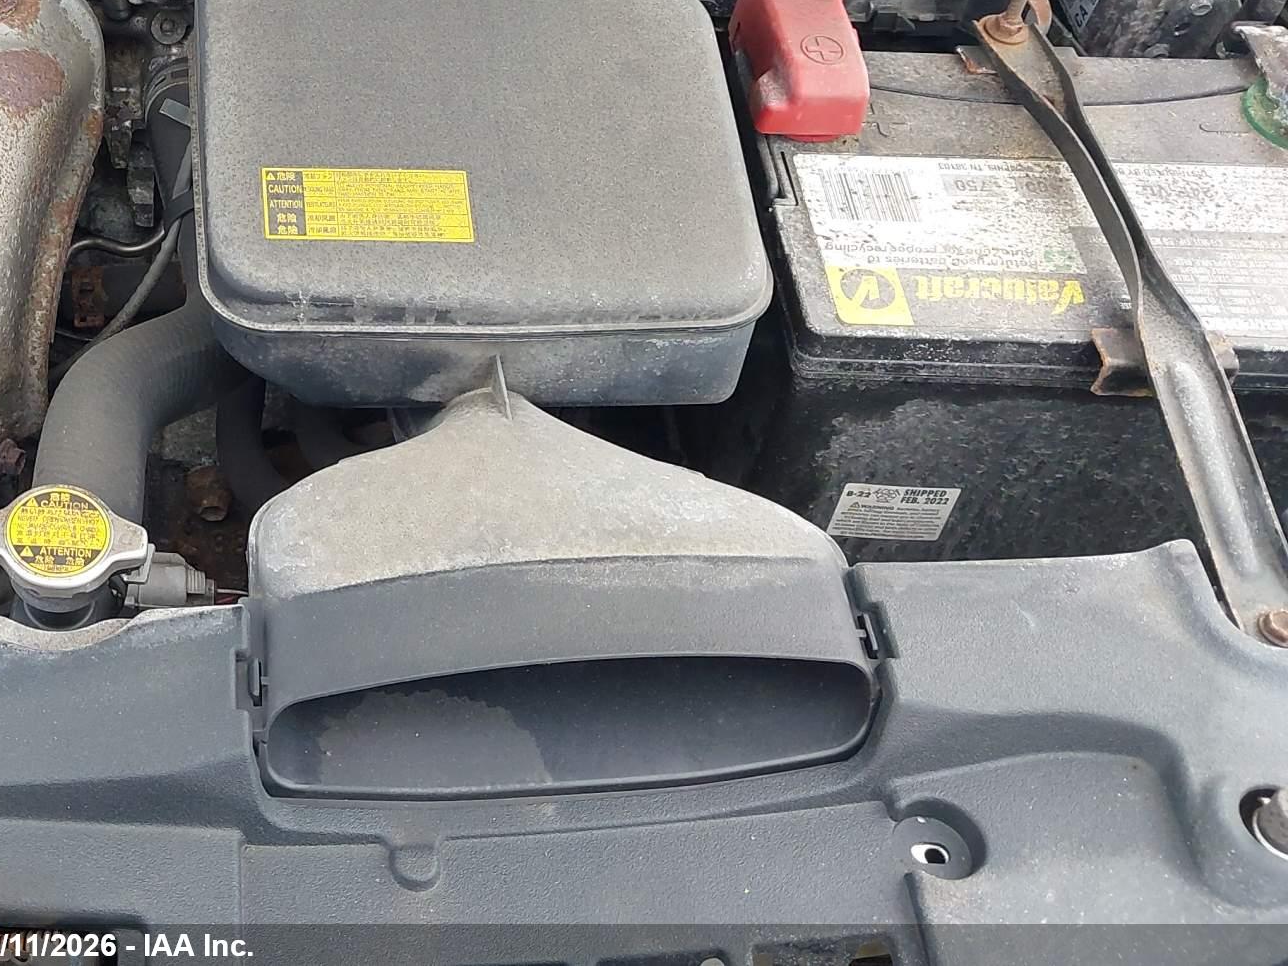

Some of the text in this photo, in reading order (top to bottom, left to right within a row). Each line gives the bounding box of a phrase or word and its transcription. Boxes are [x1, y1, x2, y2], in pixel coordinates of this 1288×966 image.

[268, 184, 304, 194] CAUTION
[269, 199, 304, 209] ATTENTION
[825, 241, 889, 254] recycling
[845, 490, 872, 498] B-22
[903, 488, 948, 498] SHIPPED
[40, 499, 89, 509] CAUTION
[899, 496, 950, 505] FEB. 2022
[39, 546, 92, 558] ATTENTION
